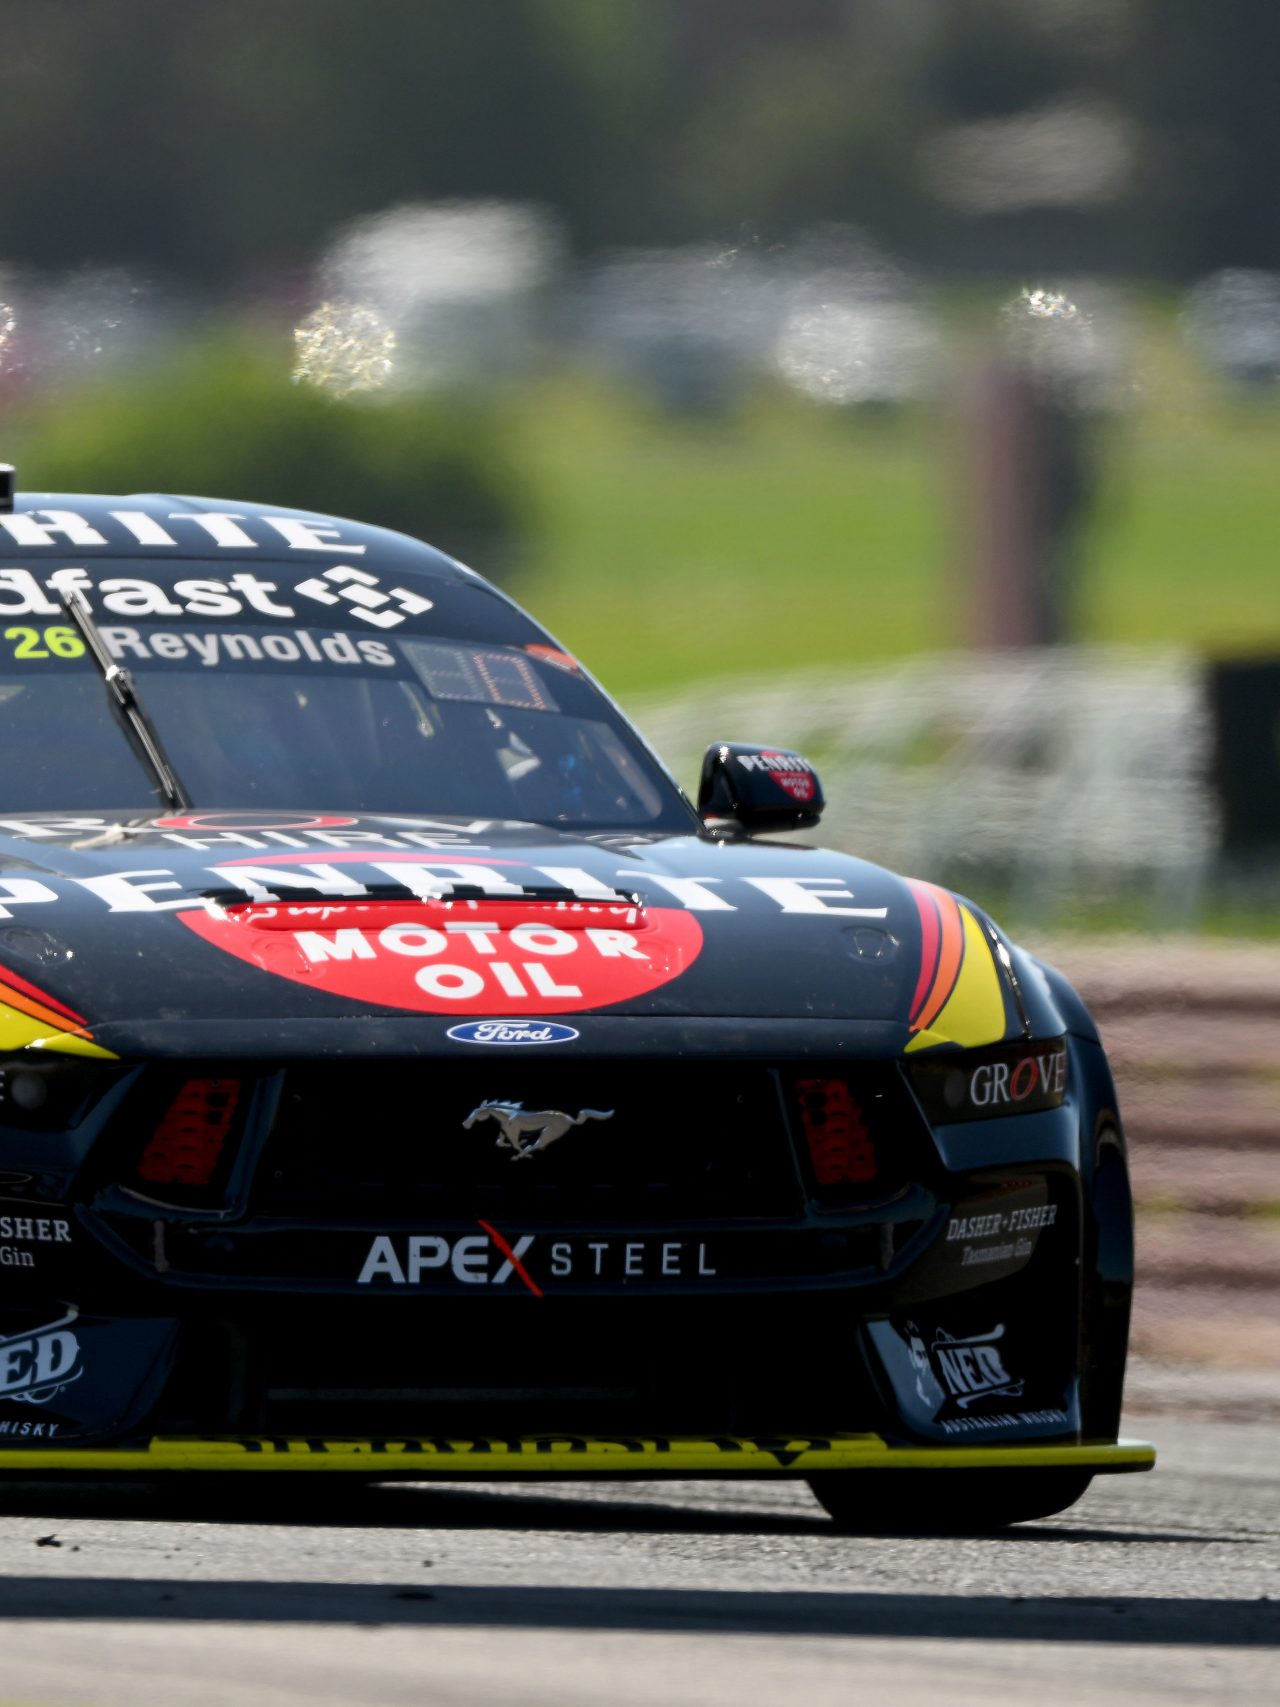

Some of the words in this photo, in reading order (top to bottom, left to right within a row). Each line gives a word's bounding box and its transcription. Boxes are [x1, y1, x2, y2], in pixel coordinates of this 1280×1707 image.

[4, 626, 86, 660] 26
[97, 625, 397, 667] Reynolds
[162, 831, 491, 851] HIRE
[292, 922, 651, 964] MOTOR
[415, 961, 583, 999] OIL
[474, 1020, 553, 1042] Ford
[970, 1052, 1065, 1106] GROVE
[946, 1213, 1002, 1241] DASHER
[1008, 1204, 1058, 1232] FISHER
[0, 1246, 35, 1267] Gin
[357, 1220, 544, 1297] APEX
[551, 1242, 717, 1275] STEEL
[935, 1346, 1012, 1395] NED
